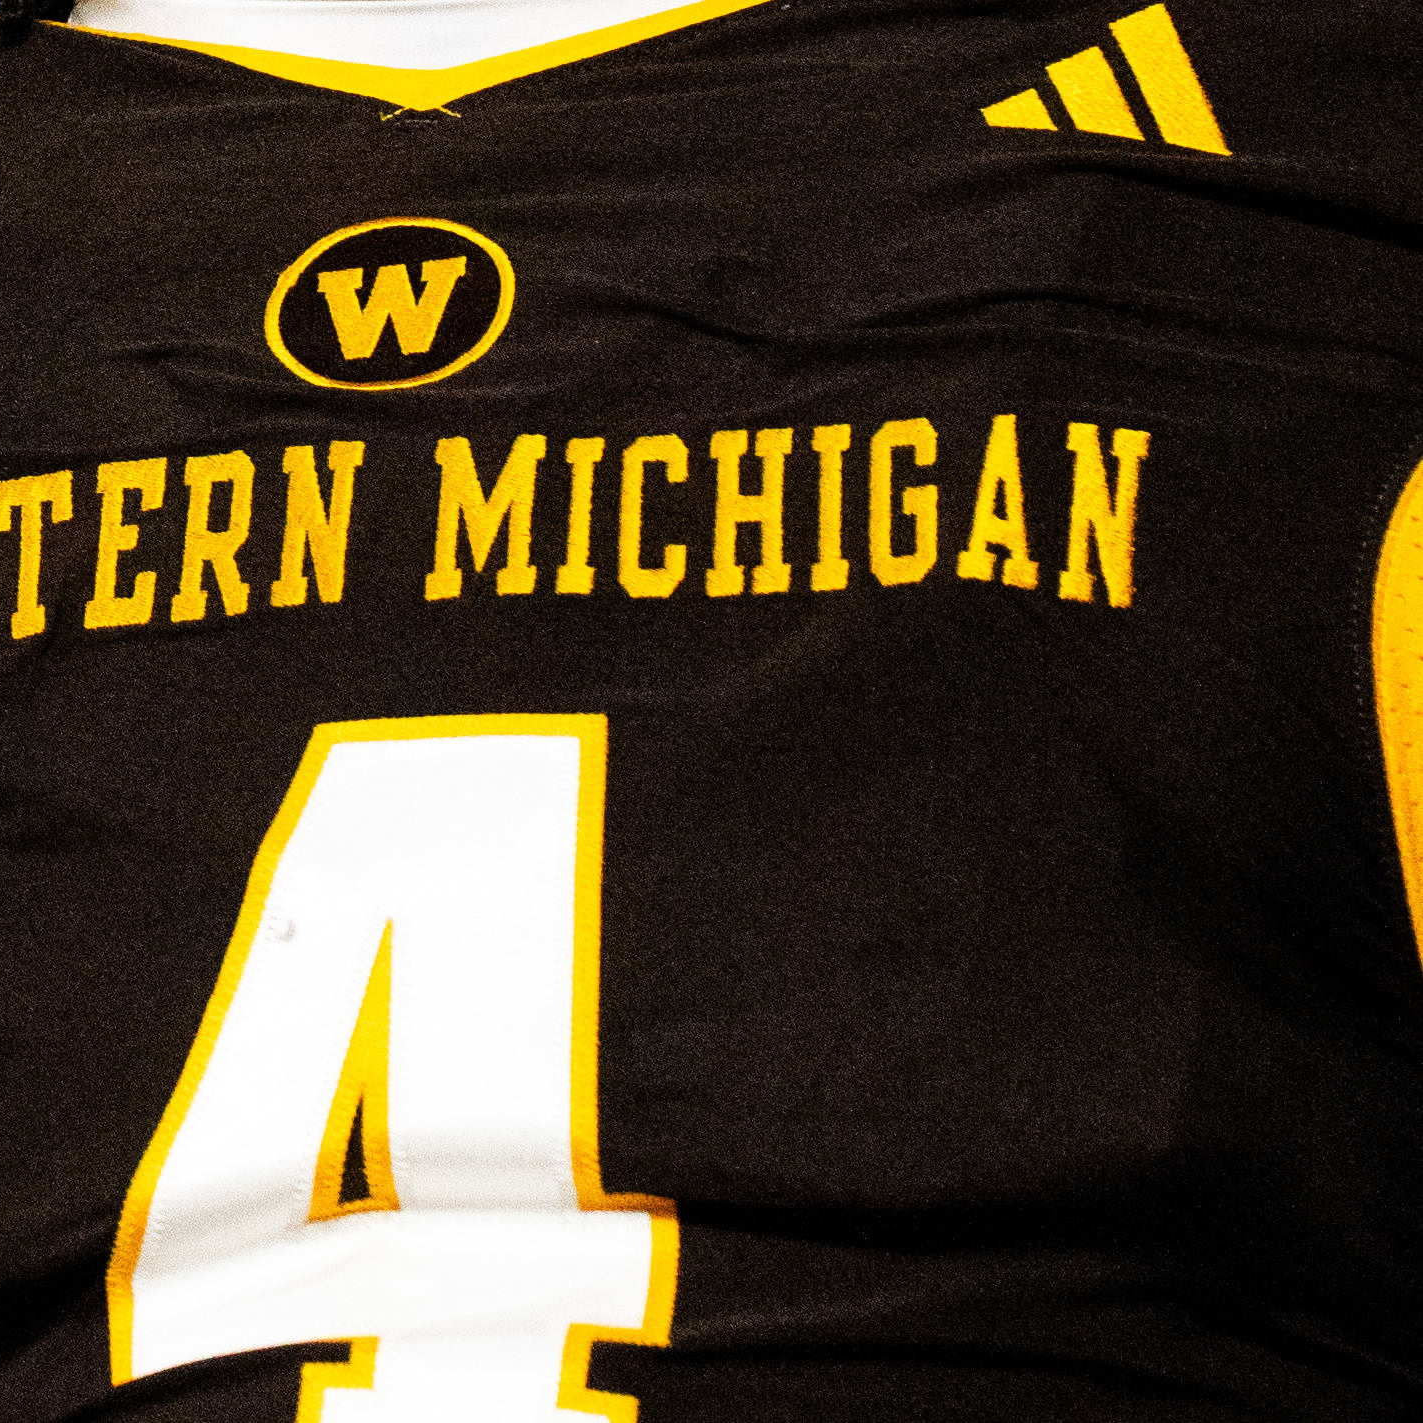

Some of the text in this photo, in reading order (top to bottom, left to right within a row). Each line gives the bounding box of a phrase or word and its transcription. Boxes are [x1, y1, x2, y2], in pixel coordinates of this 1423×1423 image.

[317, 256, 467, 361] W
[423, 413, 1151, 609] MICHIGAN
[104, 712, 681, 1423] 4
